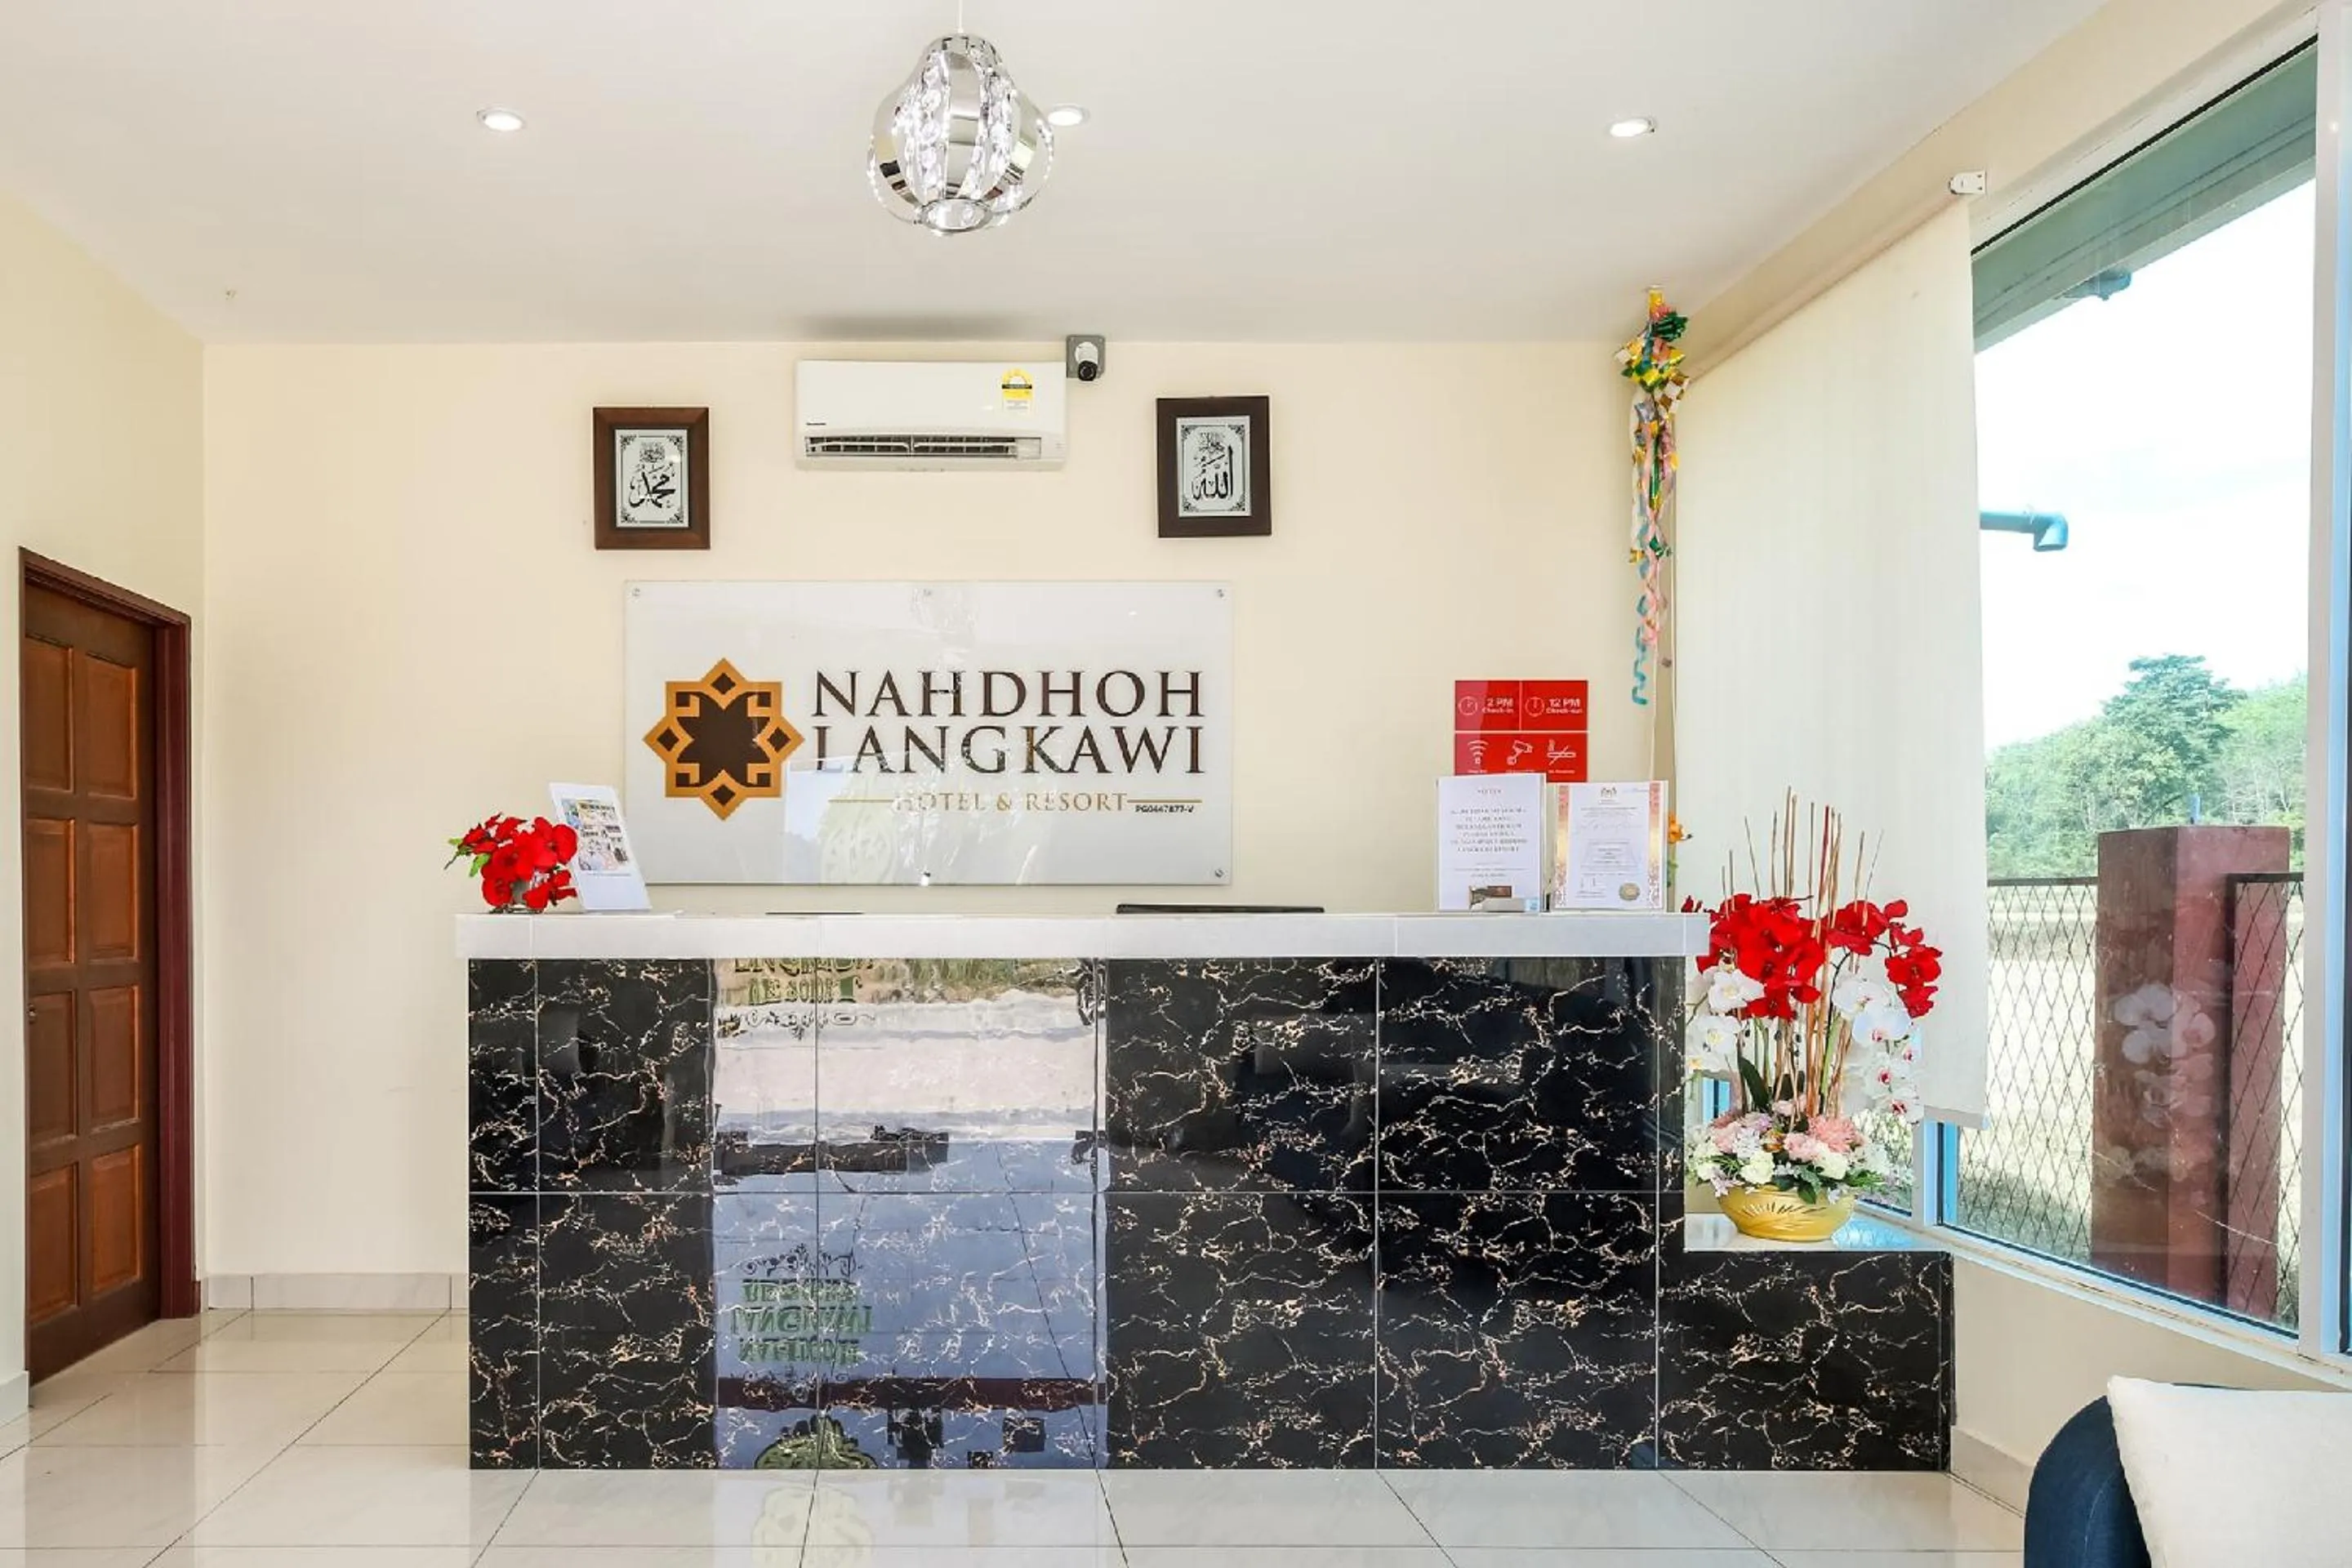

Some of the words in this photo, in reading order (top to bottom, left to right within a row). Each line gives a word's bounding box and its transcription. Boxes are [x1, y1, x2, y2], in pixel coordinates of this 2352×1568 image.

[811, 670, 1205, 717] NAHDHOH
[1486, 698, 1494, 707] 2
[1495, 698, 1514, 707] PM
[1562, 698, 1581, 707] PM
[813, 725, 1205, 774] LANGKAWI
[896, 792, 987, 812] HOTEL
[996, 792, 1013, 812] &
[1026, 792, 1128, 812] RESORT
